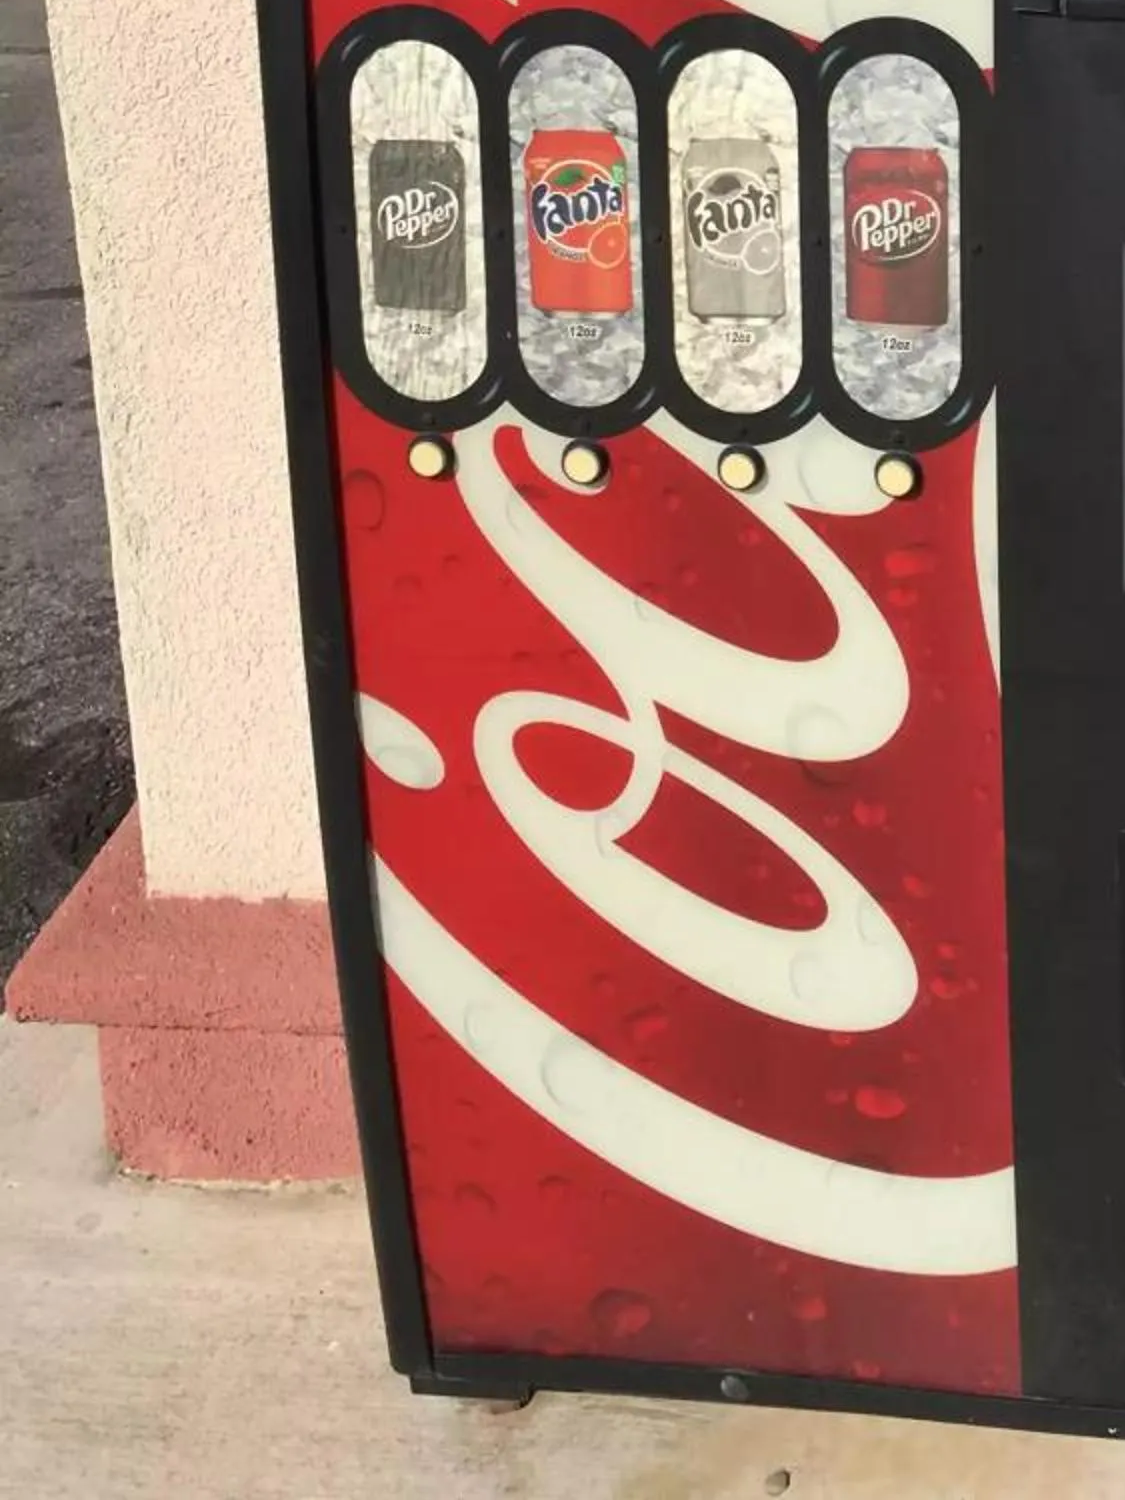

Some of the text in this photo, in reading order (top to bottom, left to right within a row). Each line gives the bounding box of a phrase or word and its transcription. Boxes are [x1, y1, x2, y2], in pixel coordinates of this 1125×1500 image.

[404, 187, 437, 215] Dr
[882, 198, 916, 226] Dr
[379, 195, 457, 241] Pepper
[856, 204, 937, 252] Pepper
[882, 338, 911, 350] 12oz
